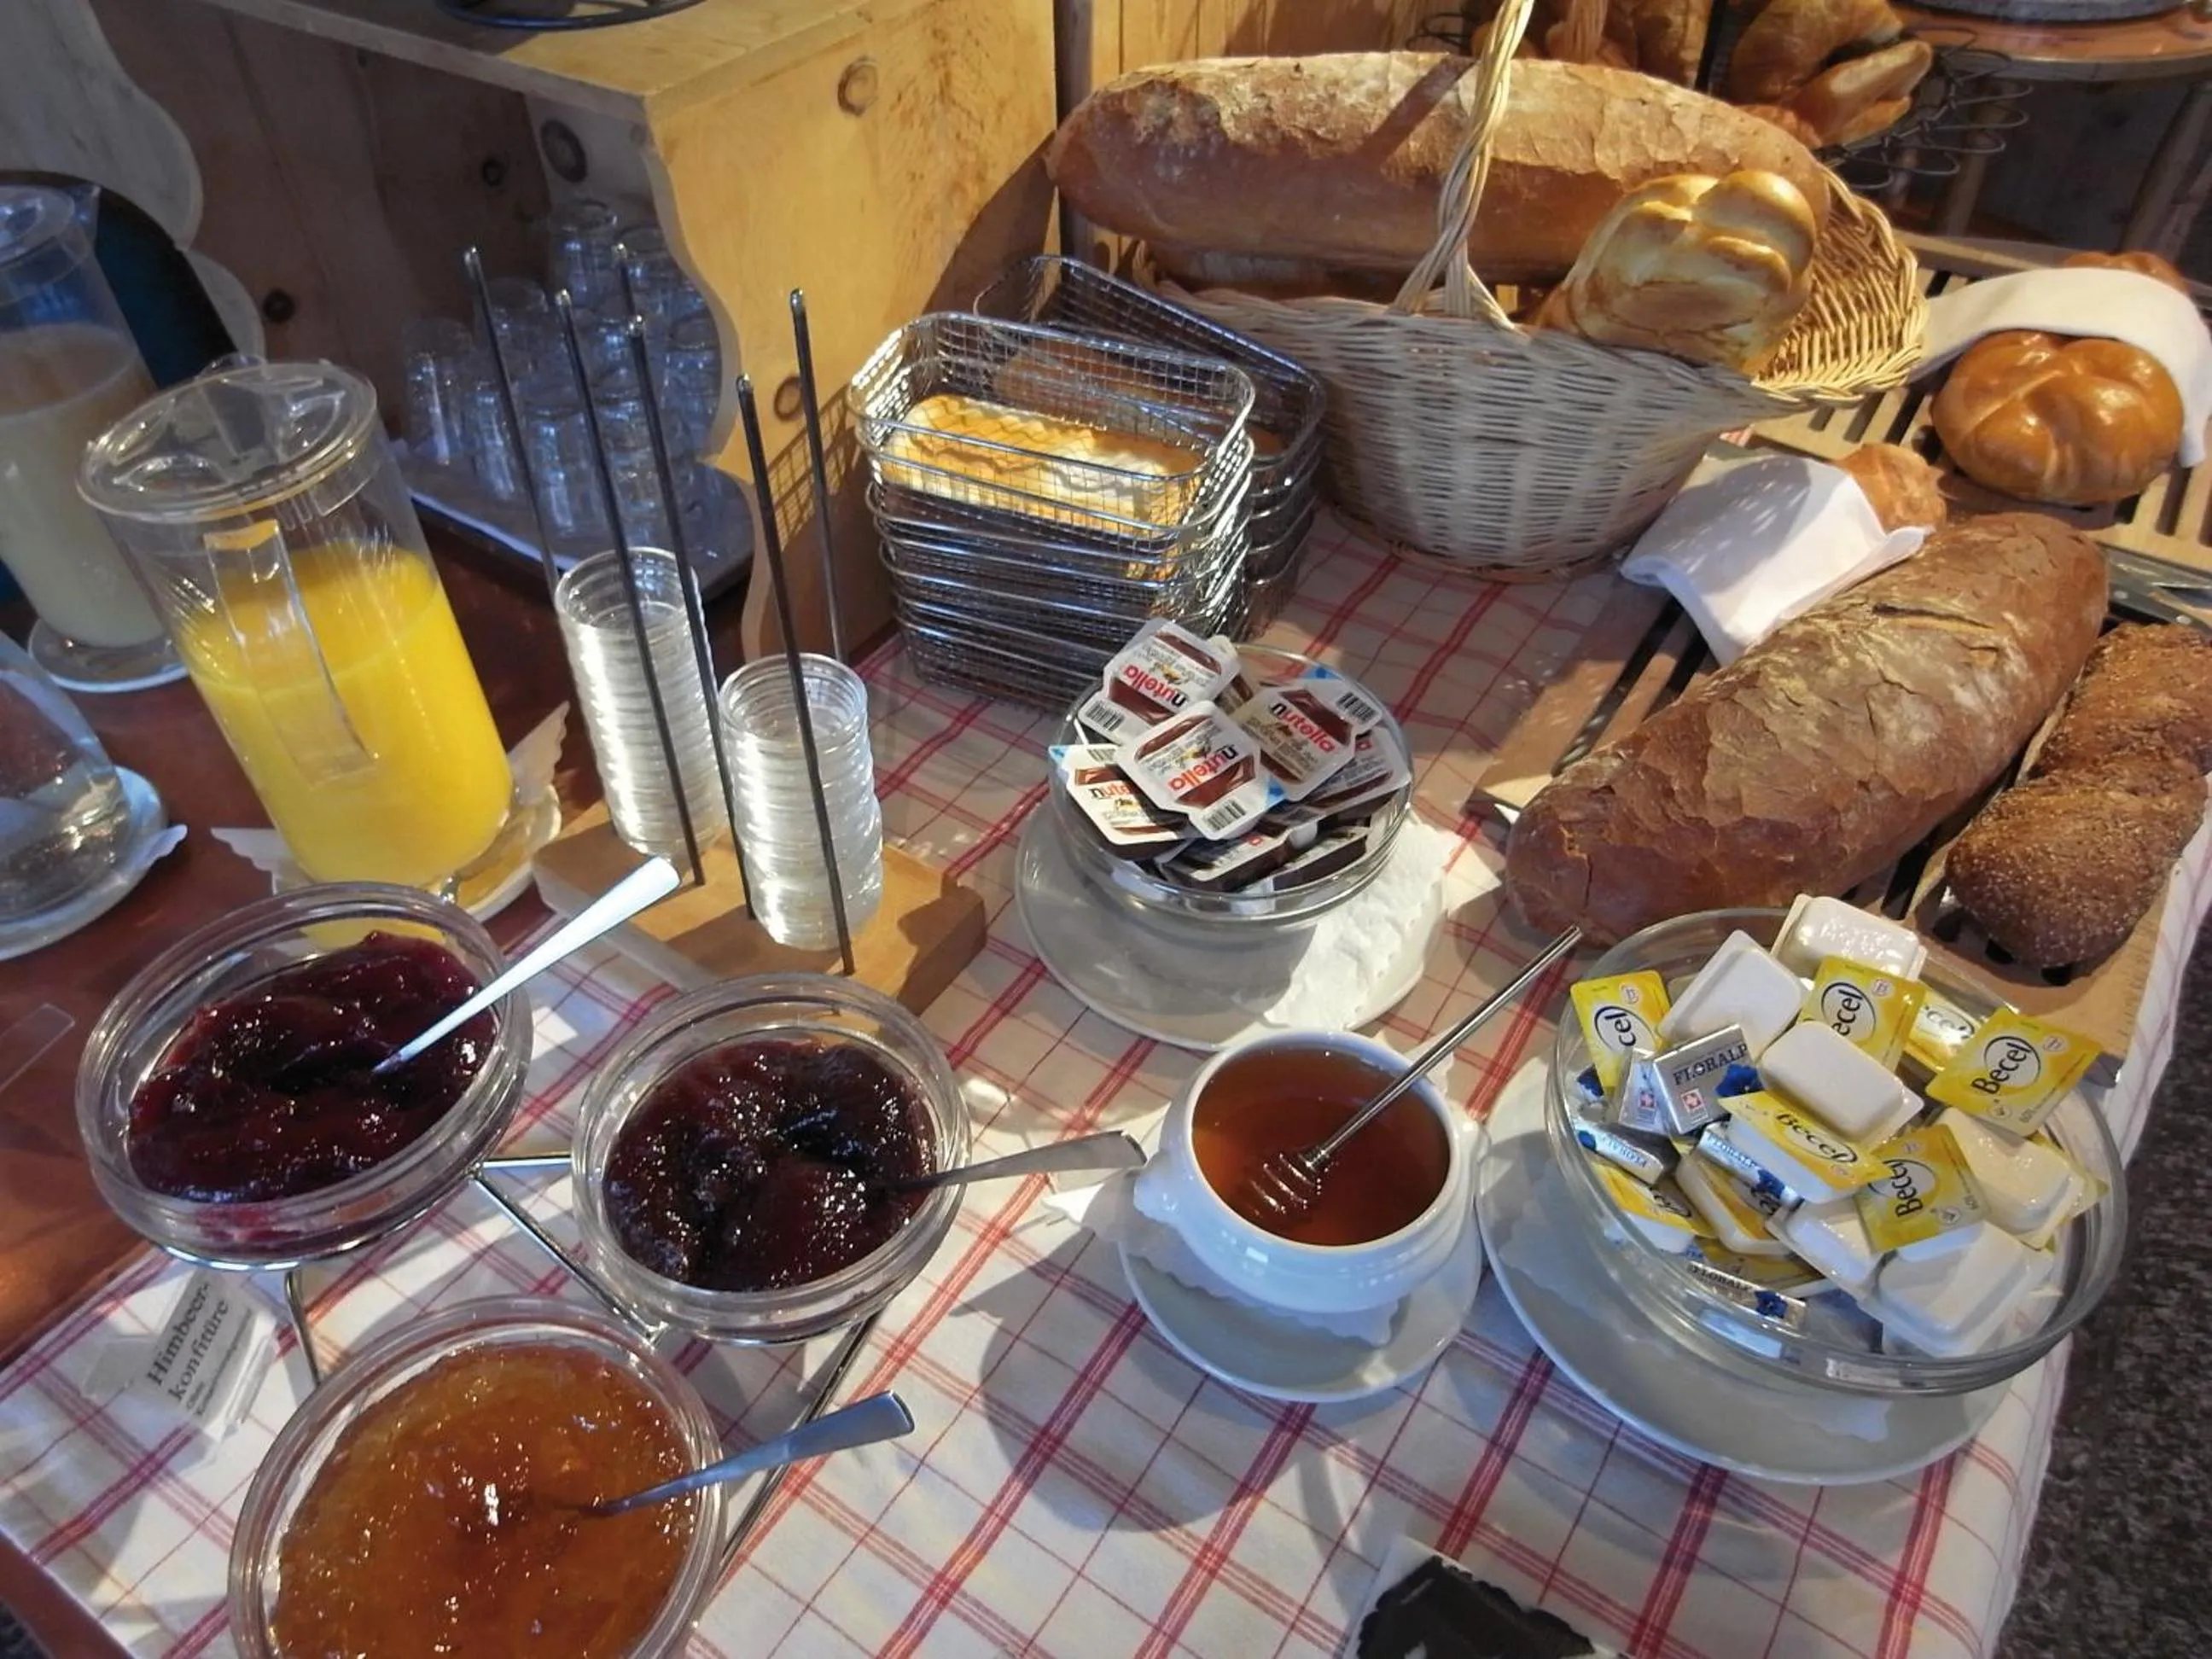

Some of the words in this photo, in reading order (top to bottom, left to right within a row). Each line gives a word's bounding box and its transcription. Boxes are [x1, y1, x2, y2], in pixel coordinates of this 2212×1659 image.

[1123, 663, 1188, 707] nutella
[1271, 701, 1336, 754] nutella
[1090, 783, 1133, 800] nute
[1169, 745, 1238, 792] nutella
[1604, 1012, 1637, 1047] cel
[1832, 989, 1864, 1037] ecel
[1673, 1043, 1748, 1086] FLORALP
[1970, 1041, 2032, 1095] Becel
[146, 1283, 210, 1387] Himbeer-
[167, 1299, 230, 1402] konfitüre
